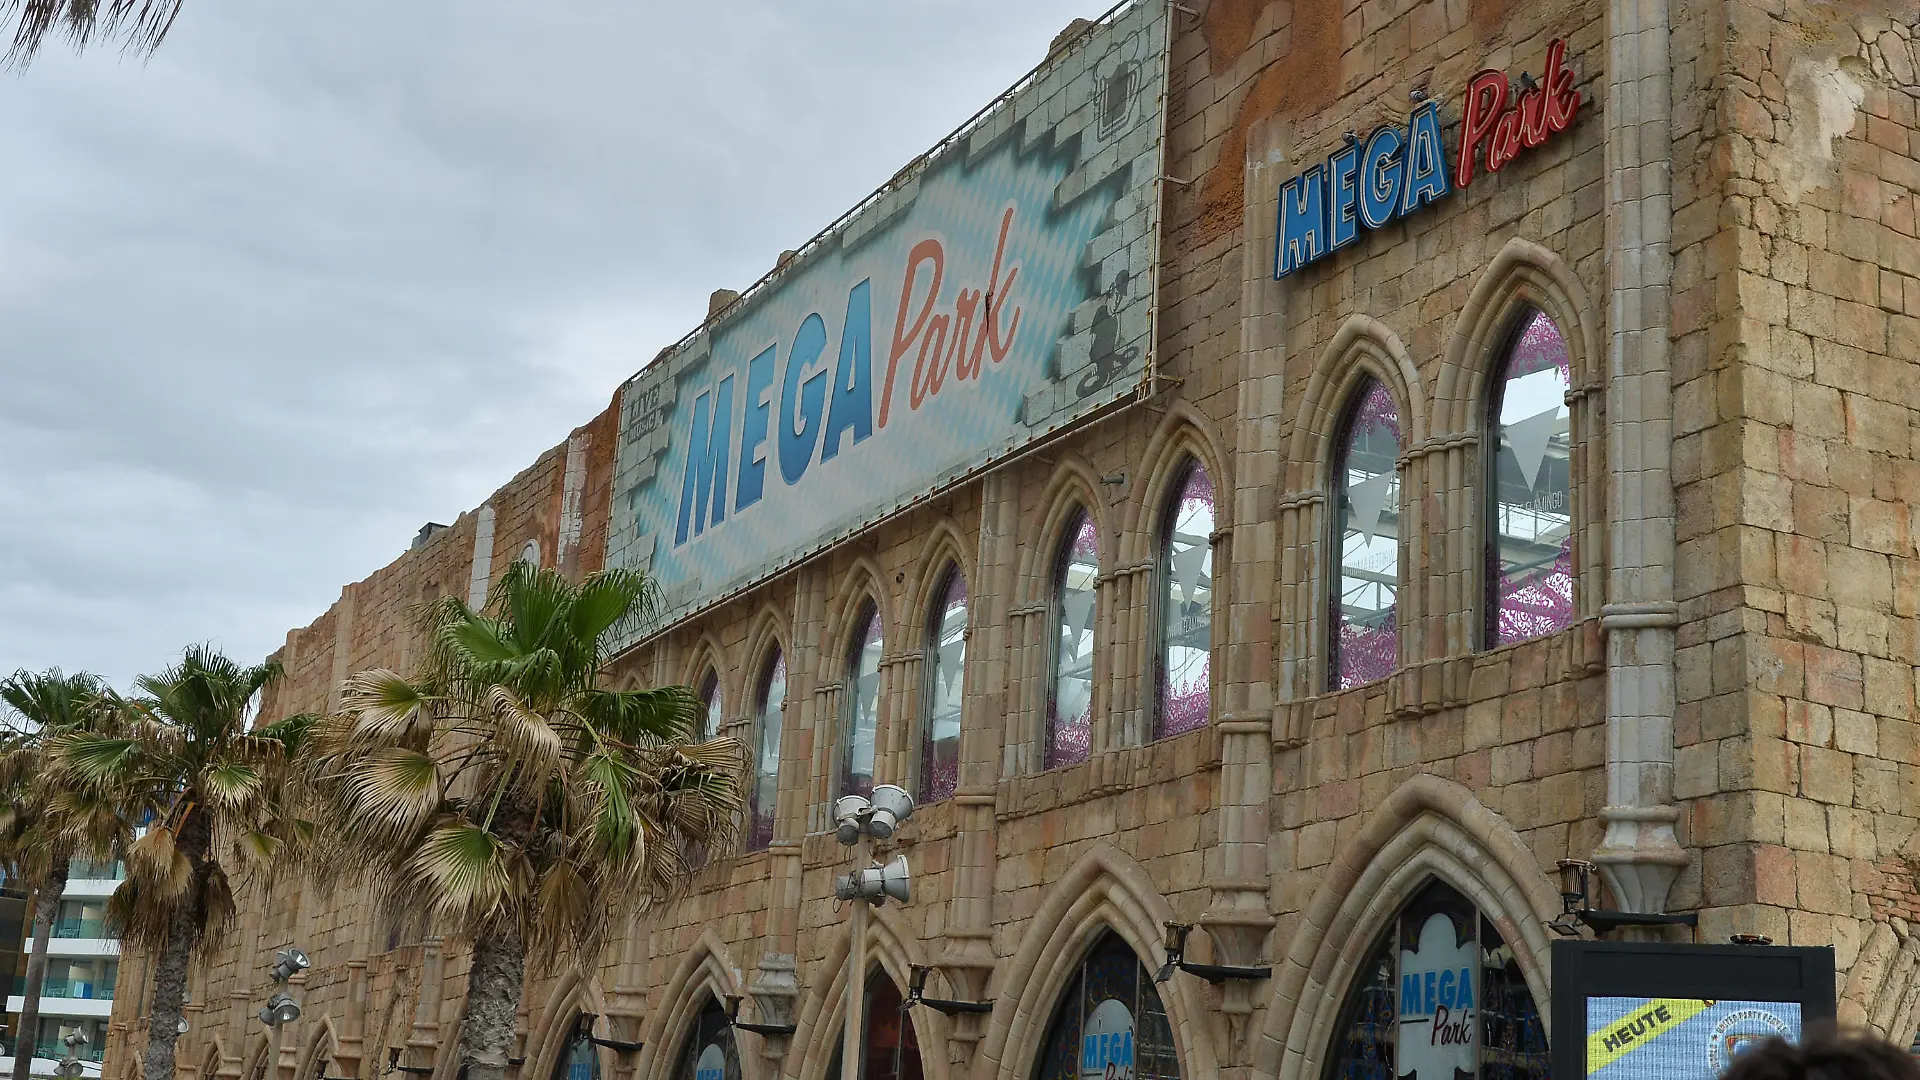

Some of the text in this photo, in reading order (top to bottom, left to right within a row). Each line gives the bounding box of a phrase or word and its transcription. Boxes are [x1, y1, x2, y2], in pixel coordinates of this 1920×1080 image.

[1273, 38, 1581, 281] MEGA Park
[673, 207, 1020, 550] MEGA Park
[629, 383, 661, 423] LIVE
[1400, 968, 1475, 1016] MEGA
[1431, 1005, 1472, 1046] Park
[1602, 1005, 1673, 1053] HEUTE
[1738, 1010, 1763, 1020] PARTY
[1082, 1031, 1133, 1069] MEGA
